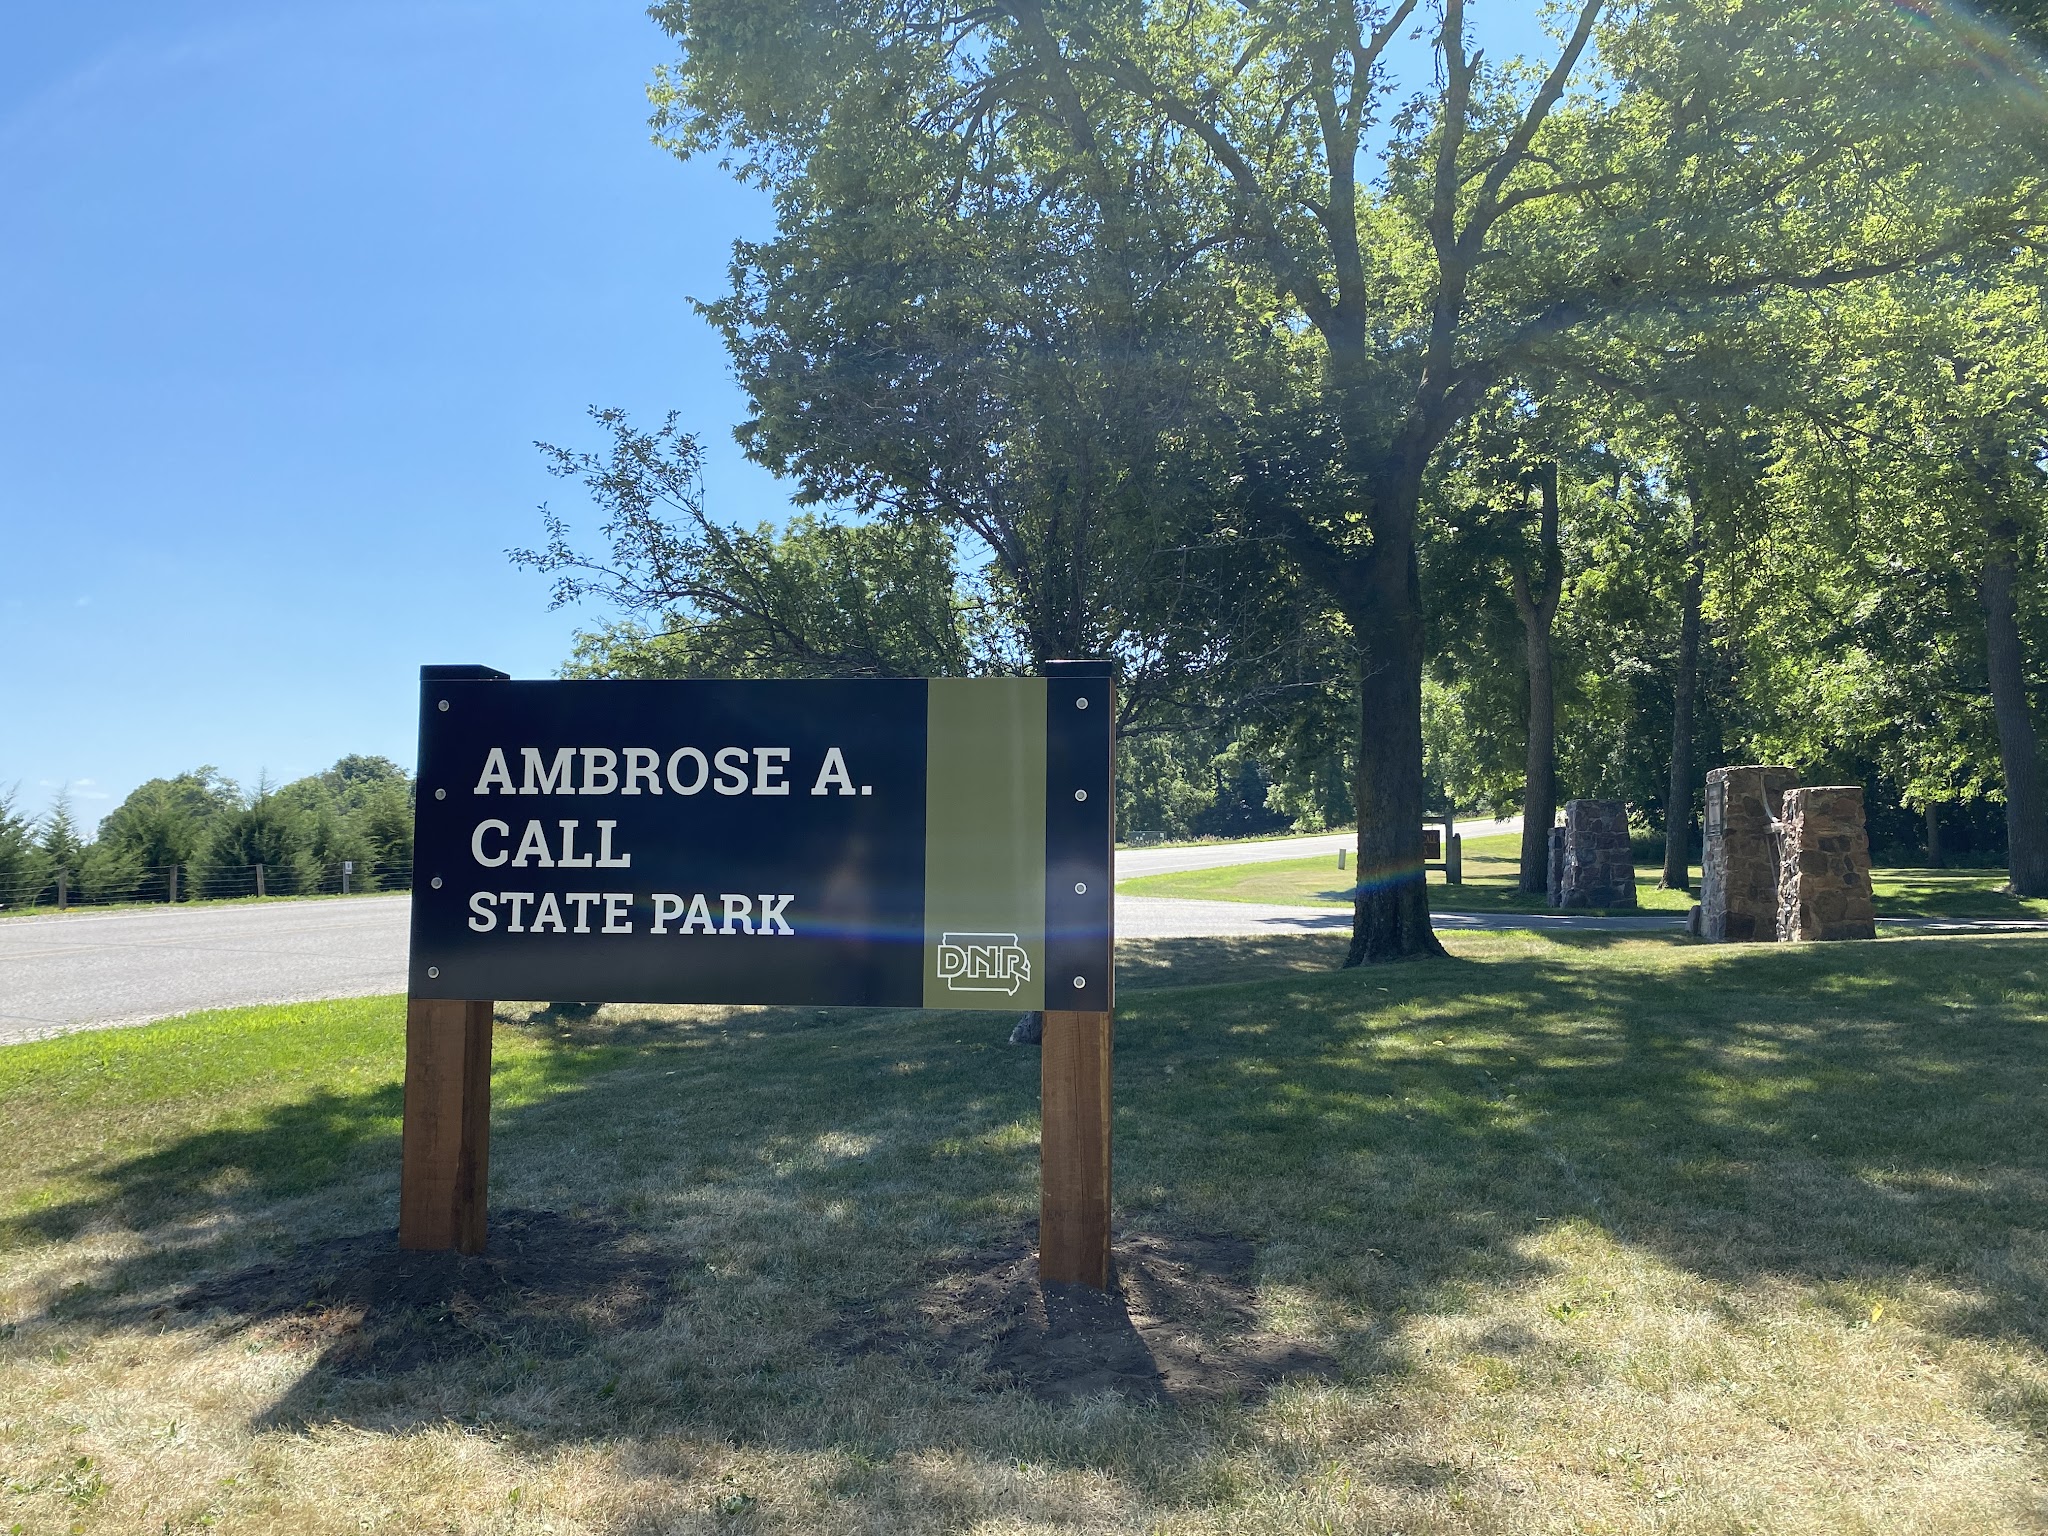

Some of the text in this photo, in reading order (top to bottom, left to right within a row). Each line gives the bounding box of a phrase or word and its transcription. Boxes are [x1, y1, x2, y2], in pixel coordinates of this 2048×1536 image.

[473, 746, 873, 796] AMBROSE A.
[471, 818, 631, 868] CALL
[468, 891, 795, 936] STATE PARK
[937, 944, 1031, 982] DNR
